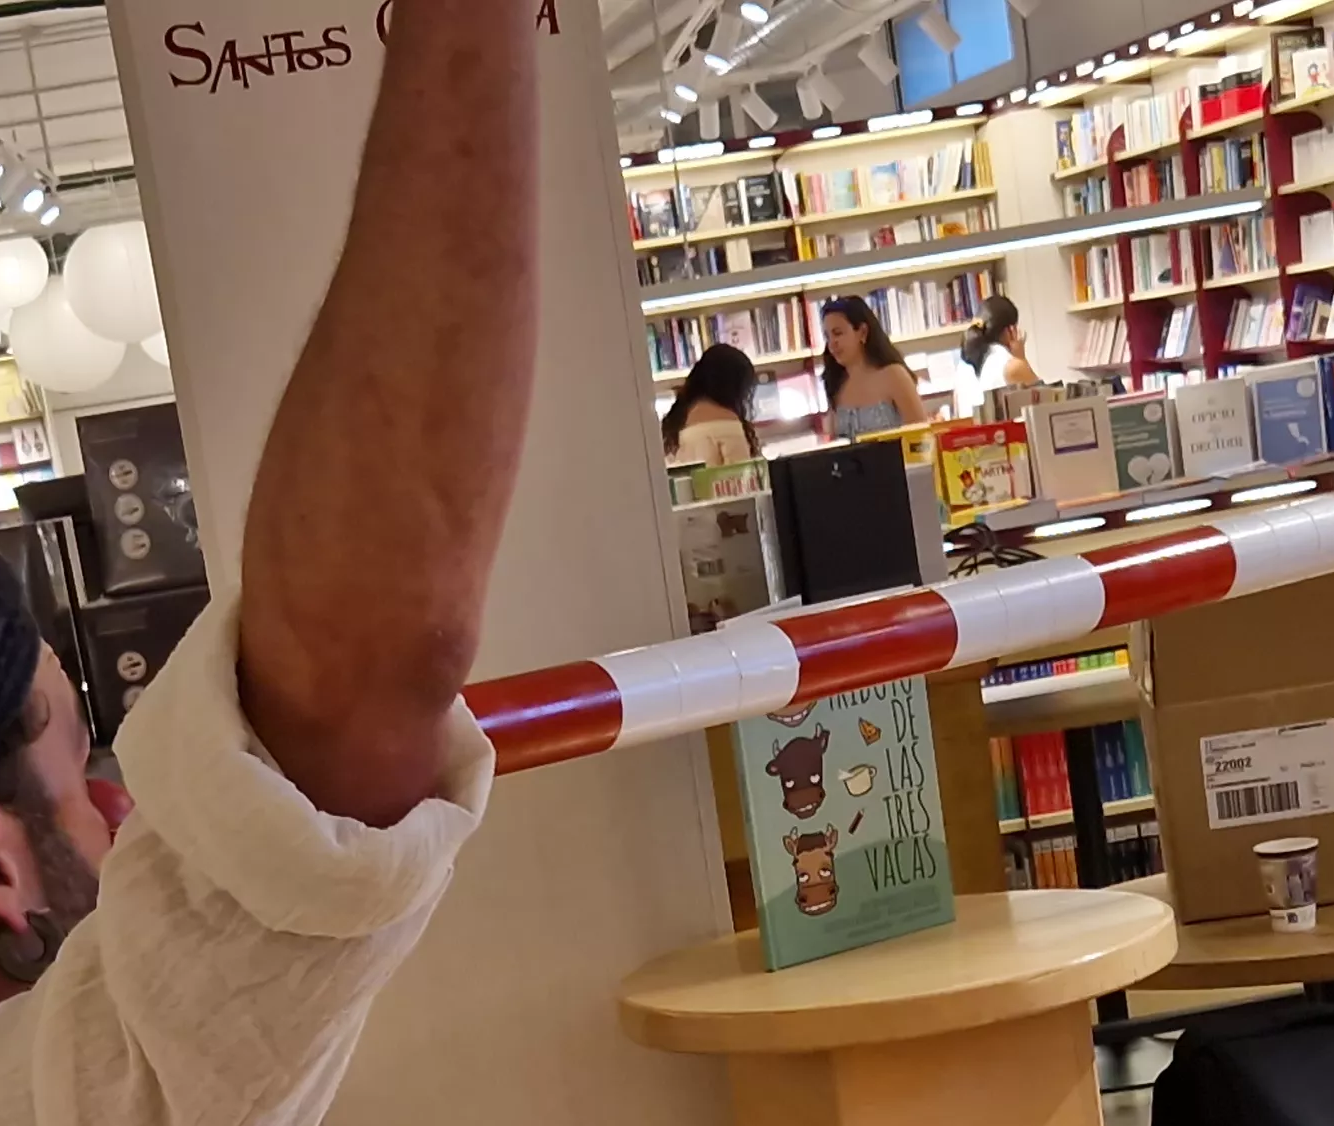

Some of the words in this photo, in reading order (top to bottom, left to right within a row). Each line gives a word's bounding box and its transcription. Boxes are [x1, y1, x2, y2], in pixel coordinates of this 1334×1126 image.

[164, 21, 352, 94] SANTOS
[891, 696, 920, 744] DE
[885, 743, 925, 793] LAS
[1215, 755, 1253, 774] 22002
[882, 789, 931, 840] TRES
[864, 834, 937, 893] VACAS
